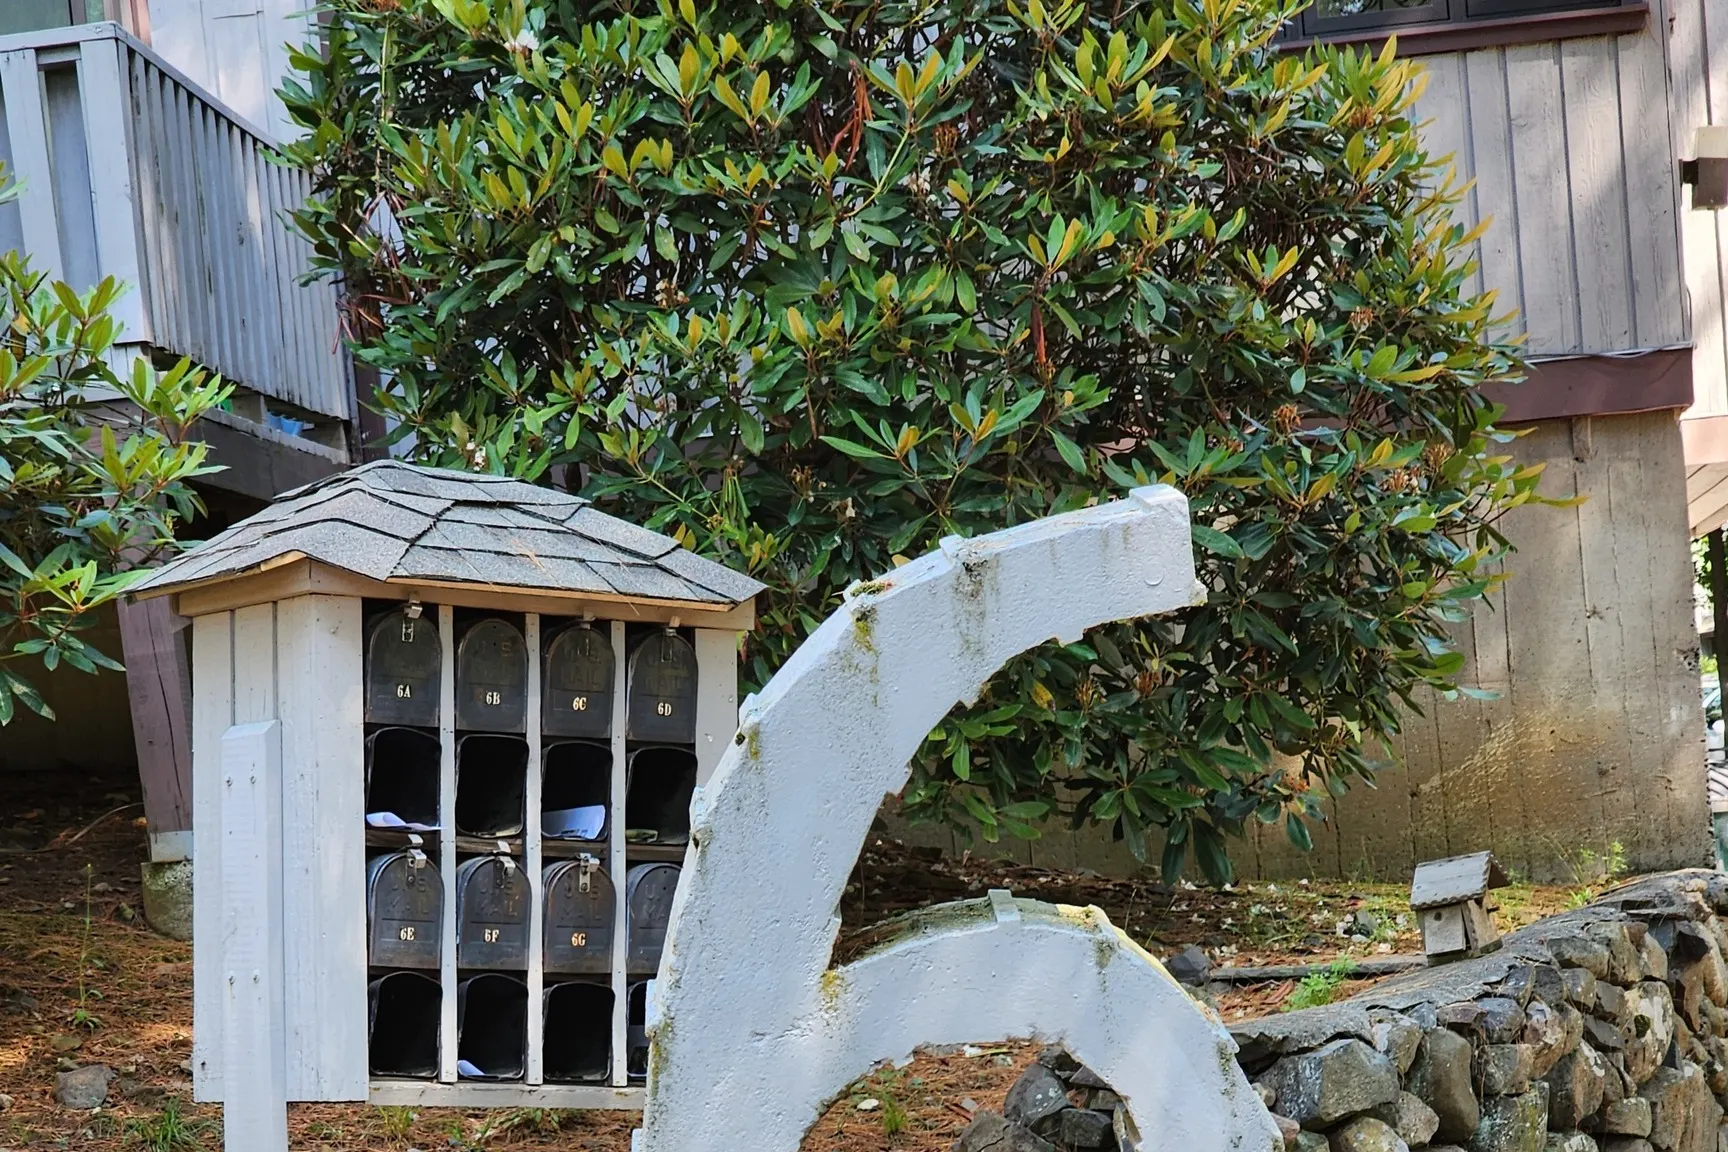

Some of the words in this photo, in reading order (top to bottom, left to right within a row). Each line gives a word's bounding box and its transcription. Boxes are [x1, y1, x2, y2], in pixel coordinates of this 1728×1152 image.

[396, 684, 411, 698] 6A
[486, 691, 501, 705] 6B
[572, 696, 587, 711] 6C
[657, 702, 672, 716] 6D
[399, 926, 415, 942] 6E
[484, 928, 500, 943] 6F
[571, 932, 586, 947] 6G
